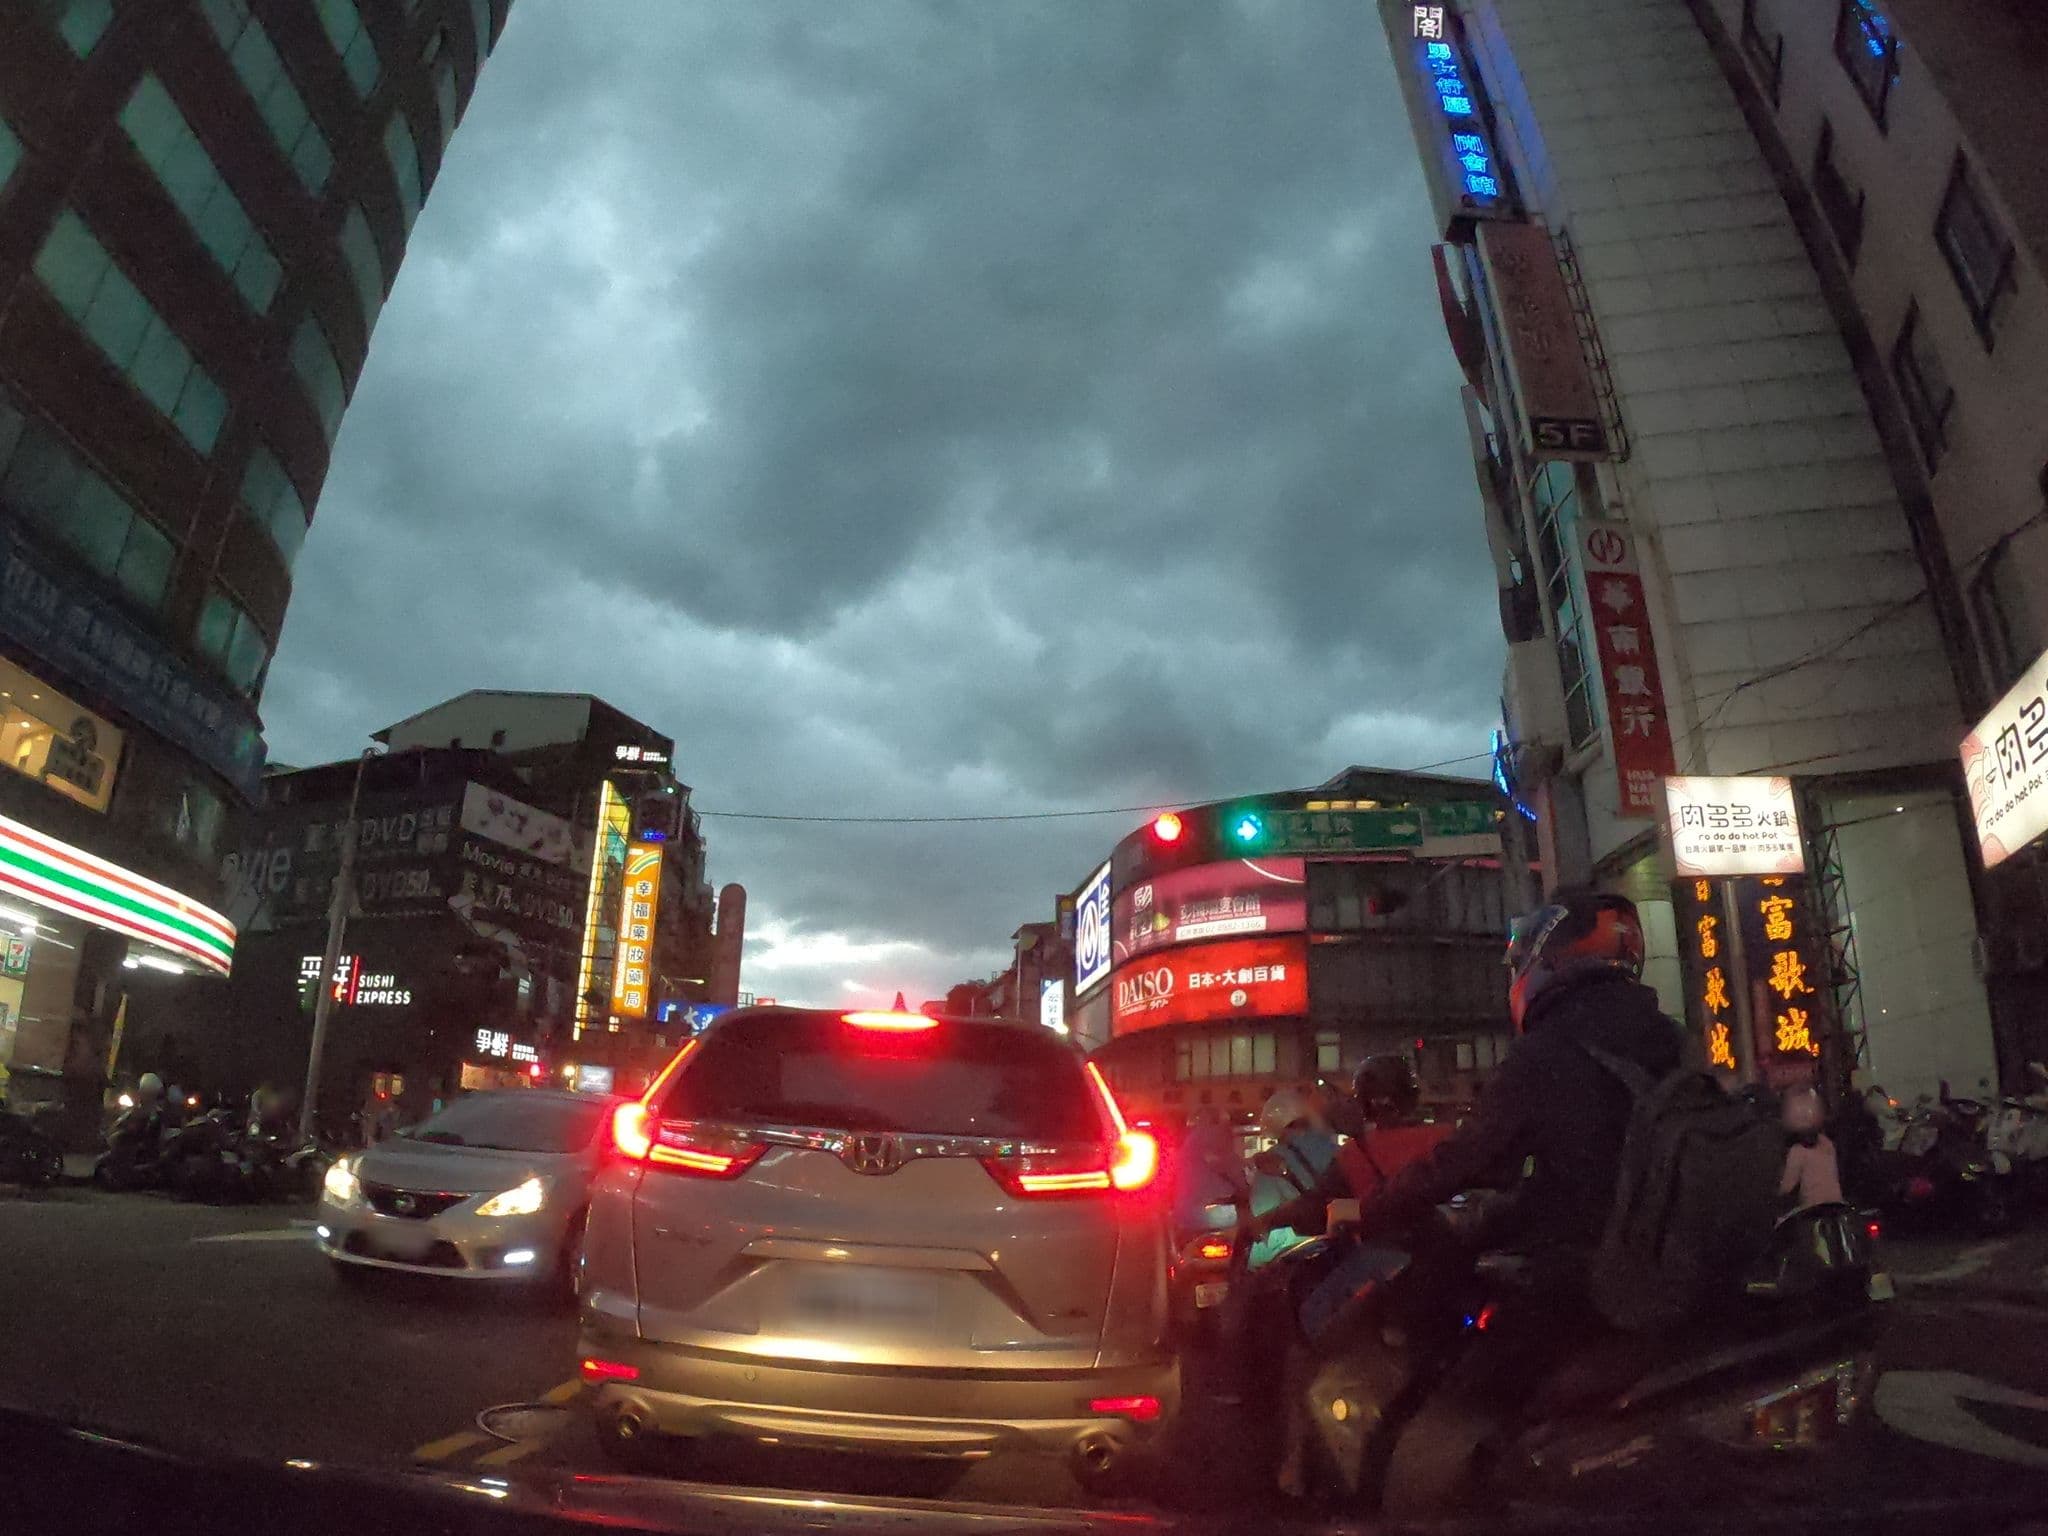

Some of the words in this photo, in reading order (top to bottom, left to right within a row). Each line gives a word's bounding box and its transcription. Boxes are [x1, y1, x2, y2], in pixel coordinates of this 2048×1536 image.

[1413, 5, 1444, 39] 閣
[1995, 676, 2048, 791] 肉多
[2015, 788, 2028, 803] hot
[1743, 832, 1760, 841] hot
[624, 880, 653, 1009] 幸福藥妝藥局
[358, 974, 395, 987] SUSHI
[1118, 966, 1174, 1008] DAISO
[355, 990, 412, 1005] EXPRESS
